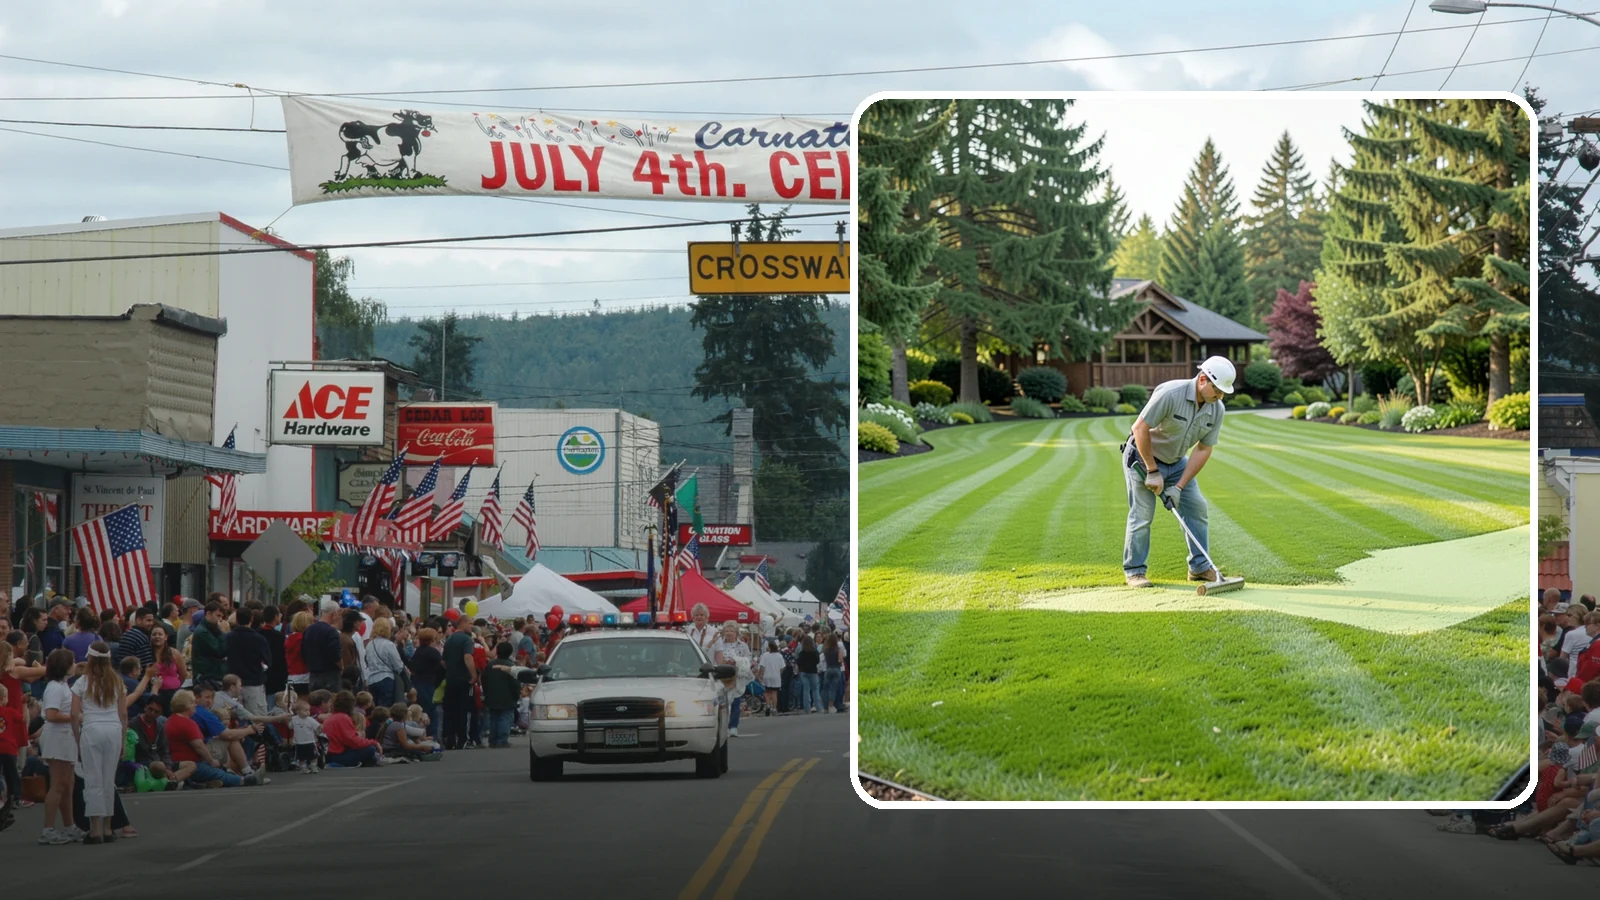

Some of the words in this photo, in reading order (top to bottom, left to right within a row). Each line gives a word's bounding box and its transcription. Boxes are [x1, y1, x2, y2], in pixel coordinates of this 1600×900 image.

[694, 121, 850, 150] Carnat
[481, 142, 605, 193] JULY
[633, 150, 747, 198] 4th.
[697, 254, 850, 280] CROSSWA
[283, 379, 374, 420] ACE
[405, 409, 452, 422] CEDAR
[461, 409, 485, 422] LOG
[283, 420, 371, 437] Hardware
[416, 428, 477, 447] Coca-Cola
[353, 466, 384, 480] Simpl
[83, 485, 92, 494] St.
[96, 485, 124, 495] Vincent
[126, 486, 136, 495] de
[137, 486, 155, 495] Paul
[212, 515, 331, 535] HARDARE
[688, 526, 741, 535] CRNATION
[699, 535, 730, 543] GLASS
